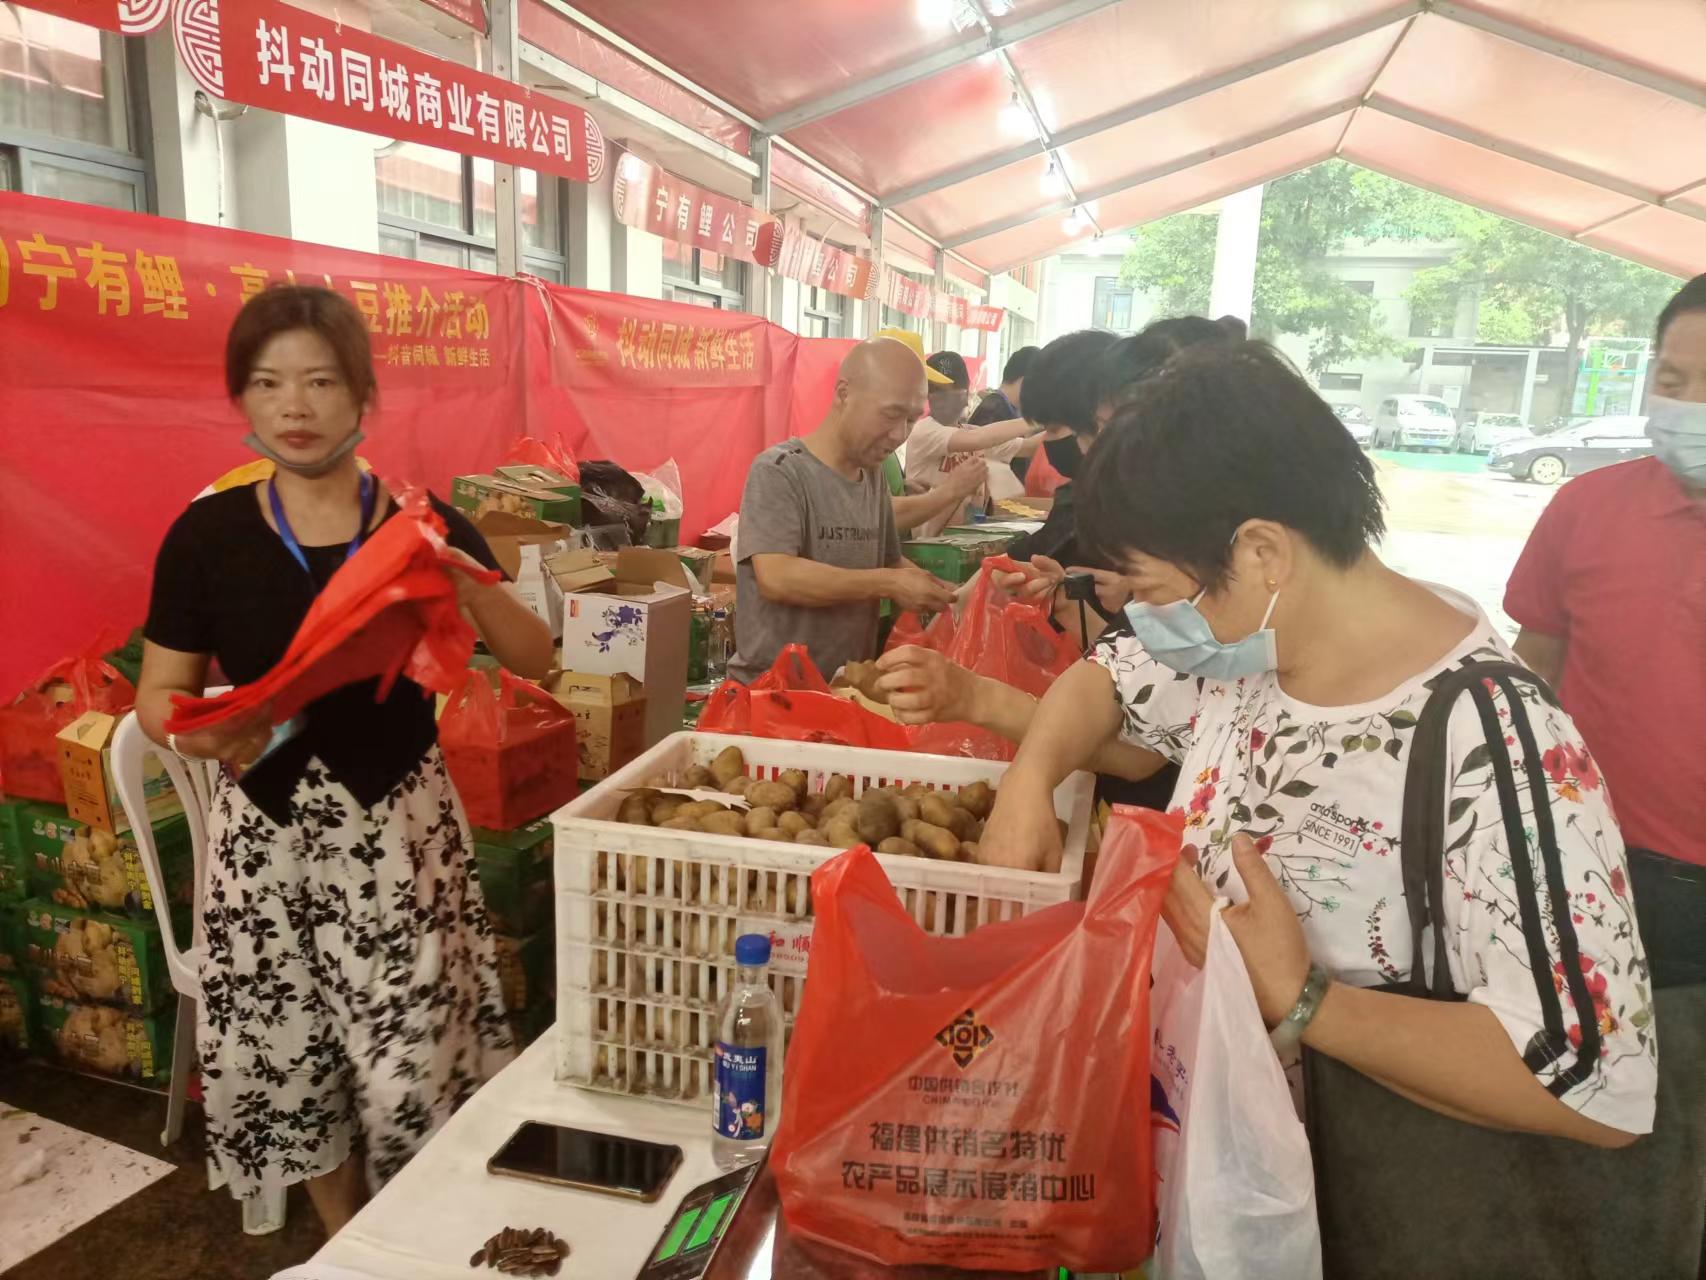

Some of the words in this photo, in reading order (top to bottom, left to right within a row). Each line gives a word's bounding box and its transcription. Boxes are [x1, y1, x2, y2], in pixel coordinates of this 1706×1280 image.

[256, 18, 573, 163] 抖动同城商业有限公司
[1303, 819, 1332, 841] SINCE
[1334, 832, 1355, 850] 1991
[870, 1121, 1066, 1163] 福建供销名特优
[842, 1160, 1096, 1202] 农产品展示展销中心
